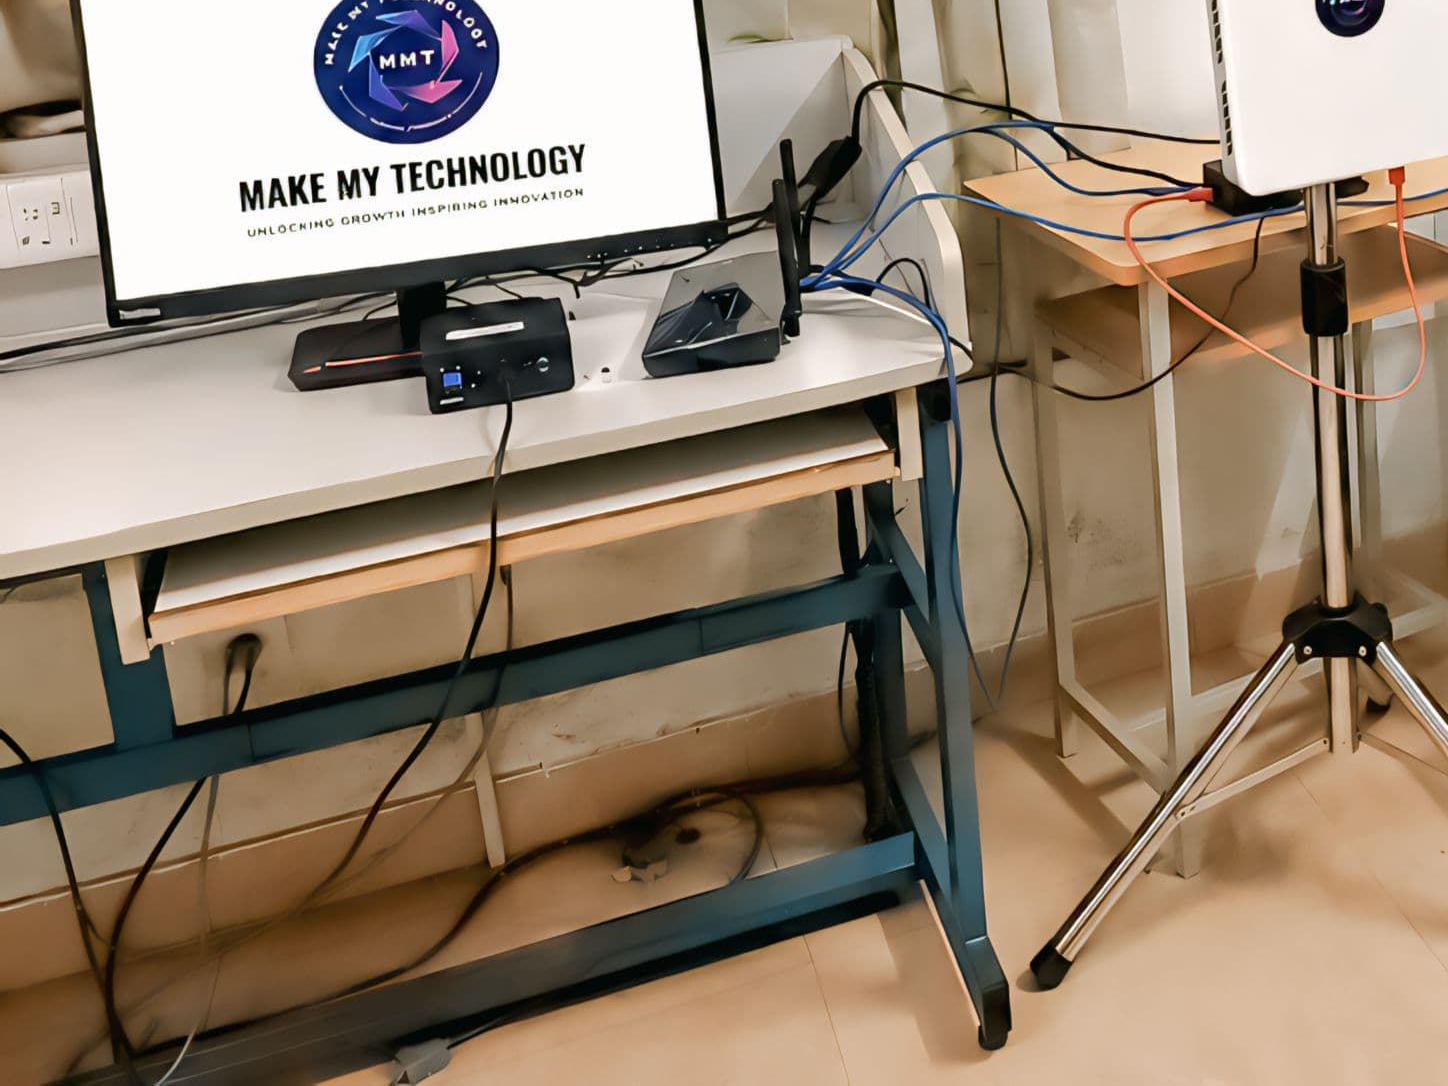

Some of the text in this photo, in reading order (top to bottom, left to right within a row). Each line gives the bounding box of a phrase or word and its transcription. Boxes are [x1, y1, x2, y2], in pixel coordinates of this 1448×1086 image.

[379, 49, 435, 69] MMT
[239, 143, 586, 213] MAKE MY TECHNOLOGY
[247, 188, 584, 237] UNLOCKING GROWTH INSPIRING INNOVATION
